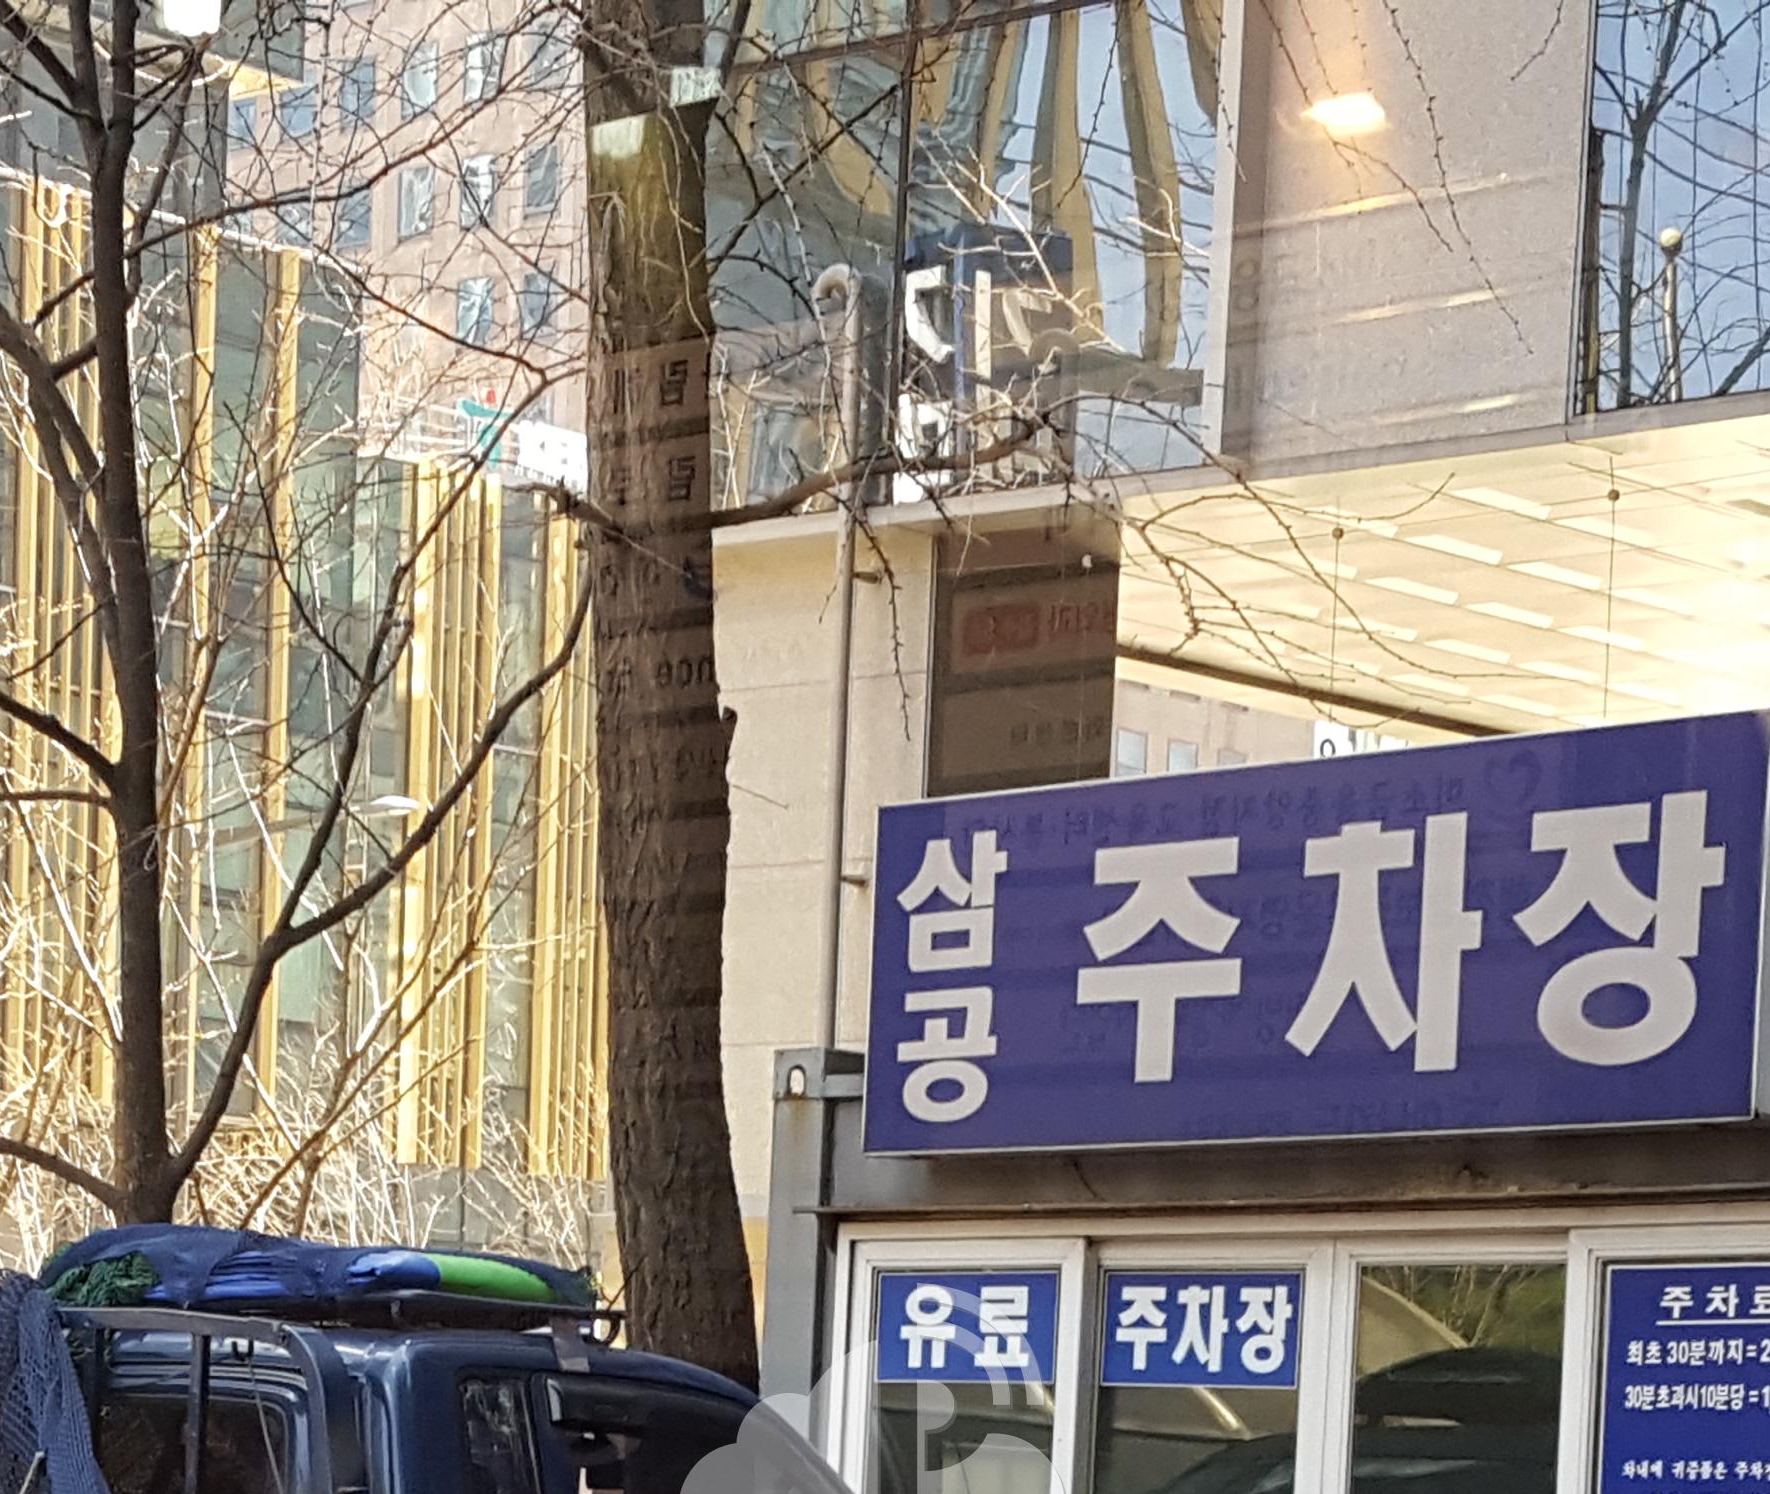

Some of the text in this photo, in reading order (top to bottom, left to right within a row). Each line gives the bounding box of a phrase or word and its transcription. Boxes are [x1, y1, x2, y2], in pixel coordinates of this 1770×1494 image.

[1075, 790, 1726, 1084] 주차장
[900, 1284, 1030, 1368] 유료
[1115, 1285, 1294, 1374] 주차장
[1626, 1340, 1662, 1366] 최초
